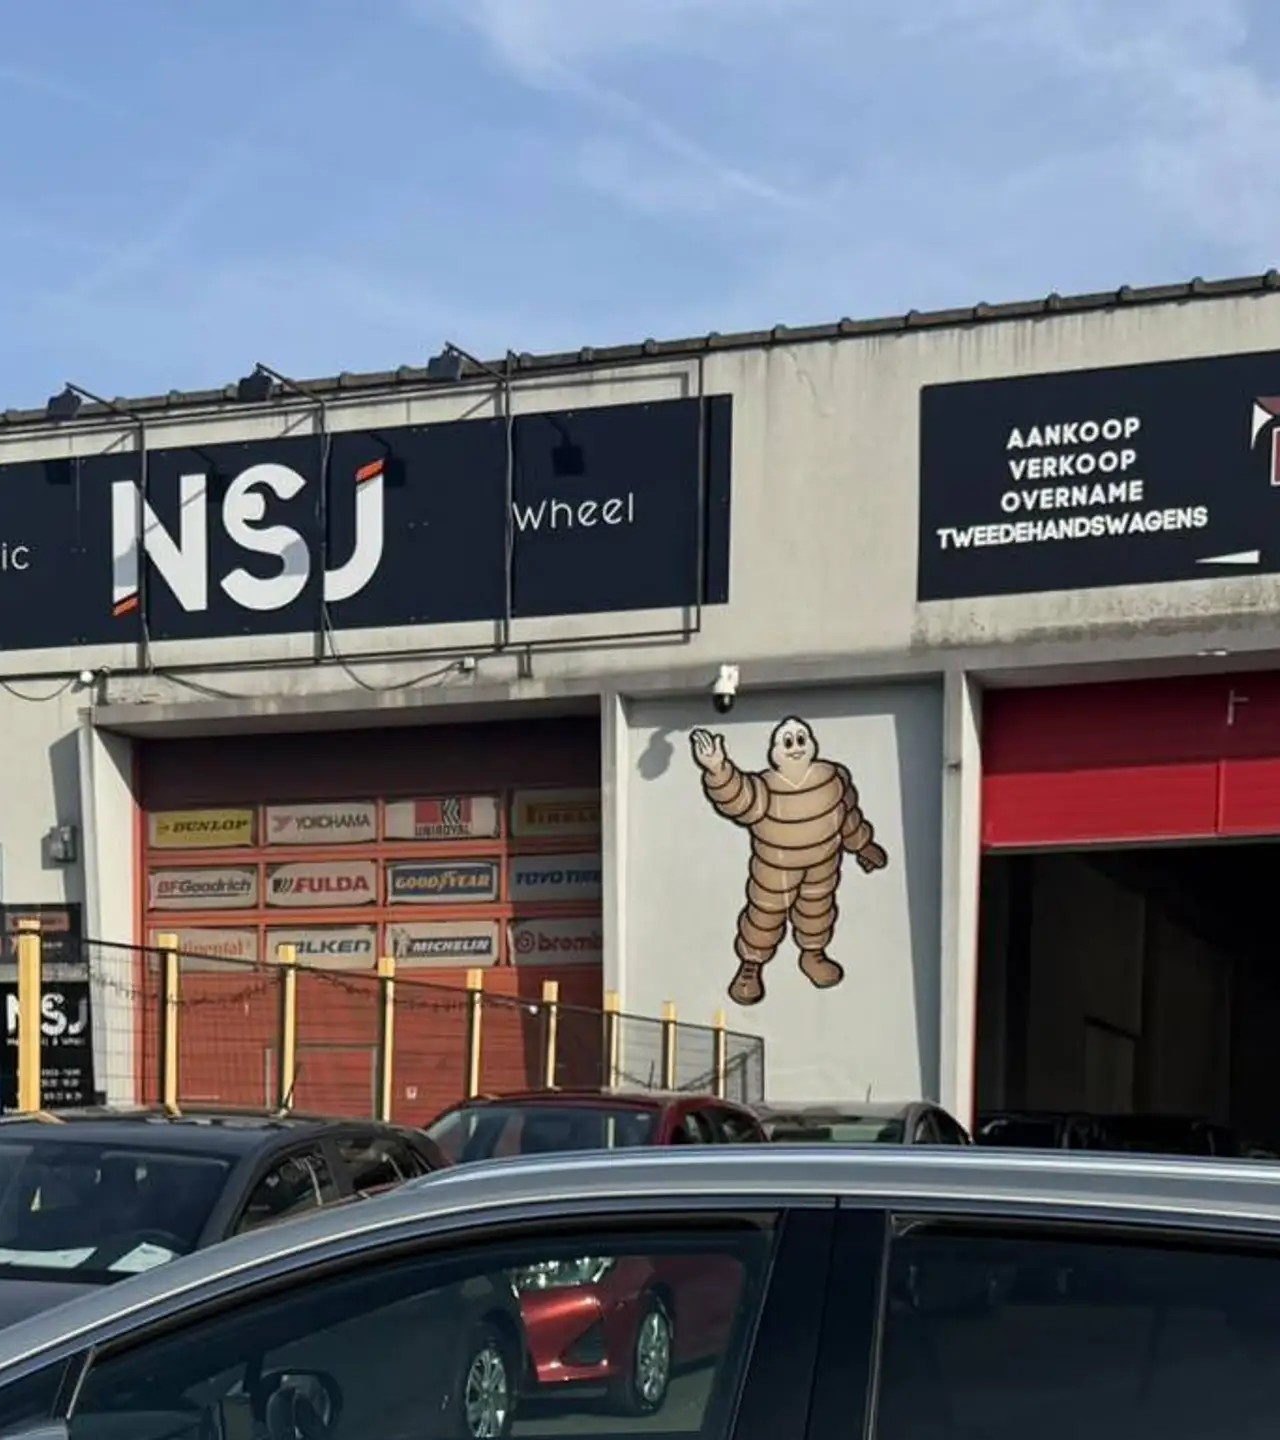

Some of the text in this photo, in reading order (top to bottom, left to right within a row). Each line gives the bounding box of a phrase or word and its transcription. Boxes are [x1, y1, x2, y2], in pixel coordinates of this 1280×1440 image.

[1006, 416, 1141, 450] AANKOOP
[1009, 448, 1137, 481] VERKOOP
[1000, 480, 1144, 512] OVERNAME
[111, 458, 386, 616] NSJ
[936, 506, 1209, 550] TWEEDEHANDSWAGENS
[172, 819, 249, 834] DUNLOP
[295, 814, 371, 830] YOKOHAMA
[157, 876, 252, 894] BFGoodrich
[292, 875, 370, 894] FULDA
[395, 871, 491, 892] GOODYEAR
[412, 938, 491, 953] MICHELIN
